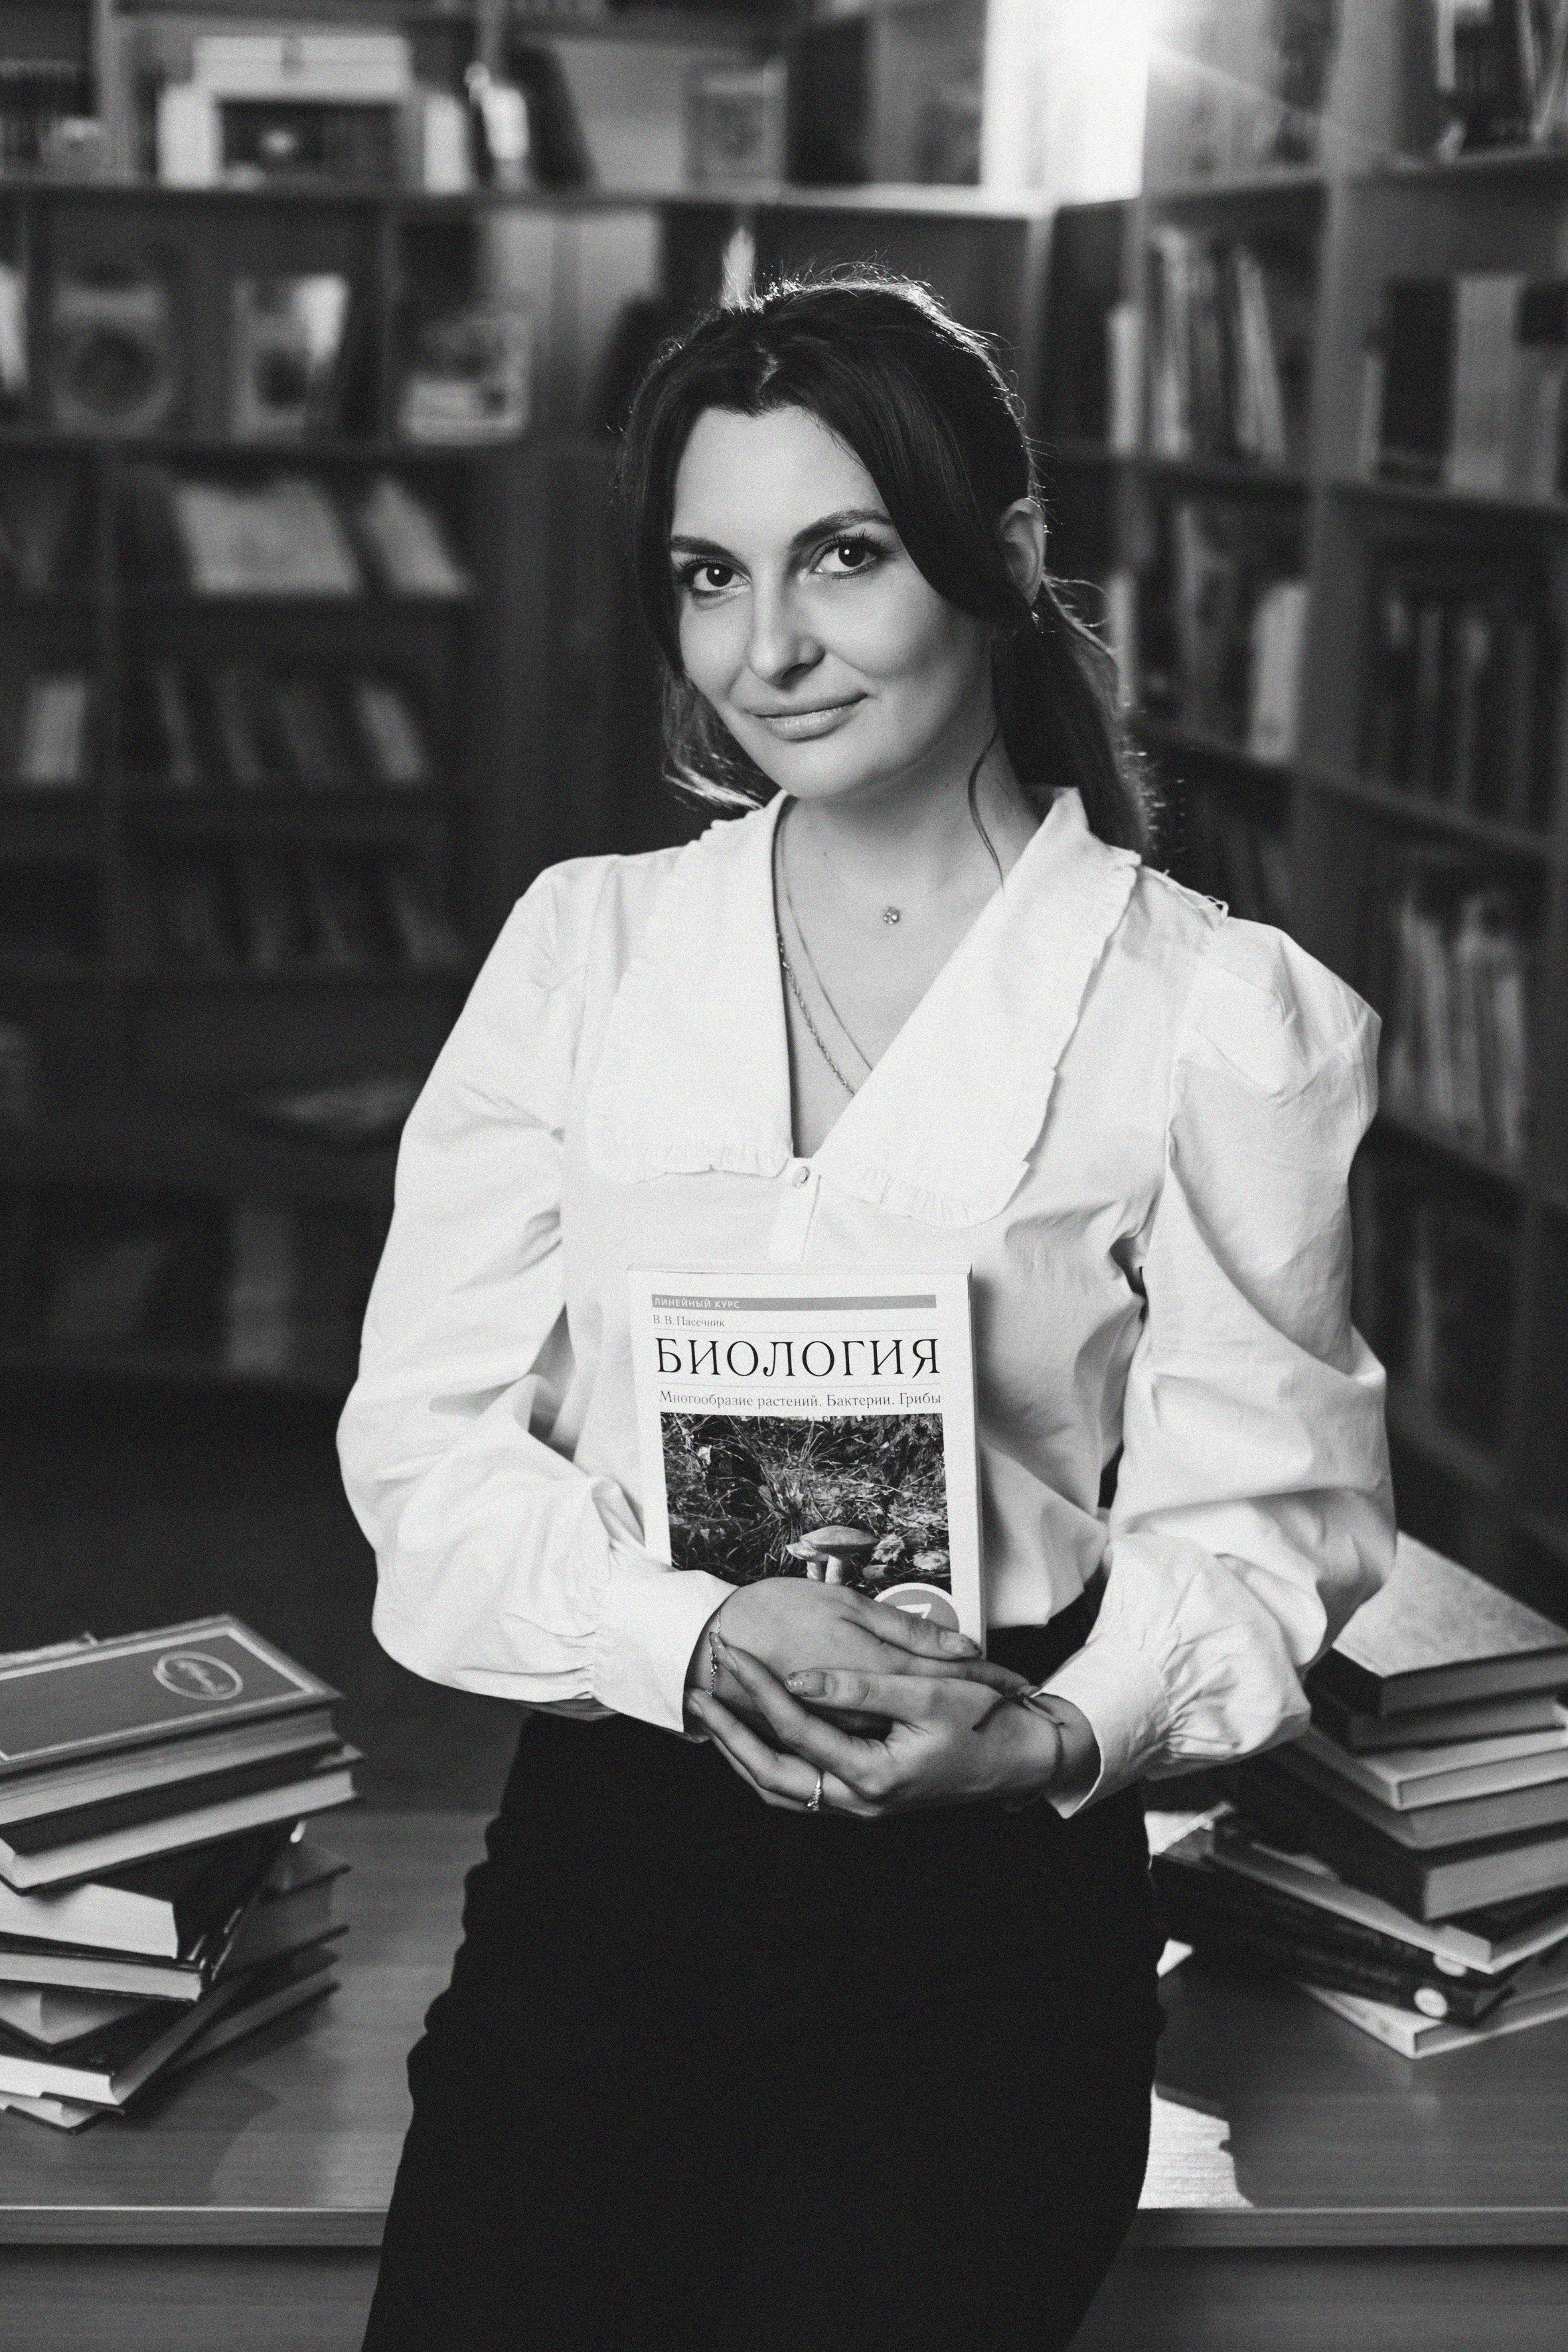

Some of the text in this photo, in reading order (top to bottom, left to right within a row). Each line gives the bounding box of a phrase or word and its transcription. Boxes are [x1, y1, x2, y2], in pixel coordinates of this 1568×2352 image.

[654, 1297, 740, 1309] ЛИНЕЙНЫЙ КУРС
[677, 1316, 725, 1327] Пасечник
[655, 1338, 941, 1378] БИОЛОГИЯ
[660, 1390, 941, 1409] Многообразие растений. Бактерии. Грибы
